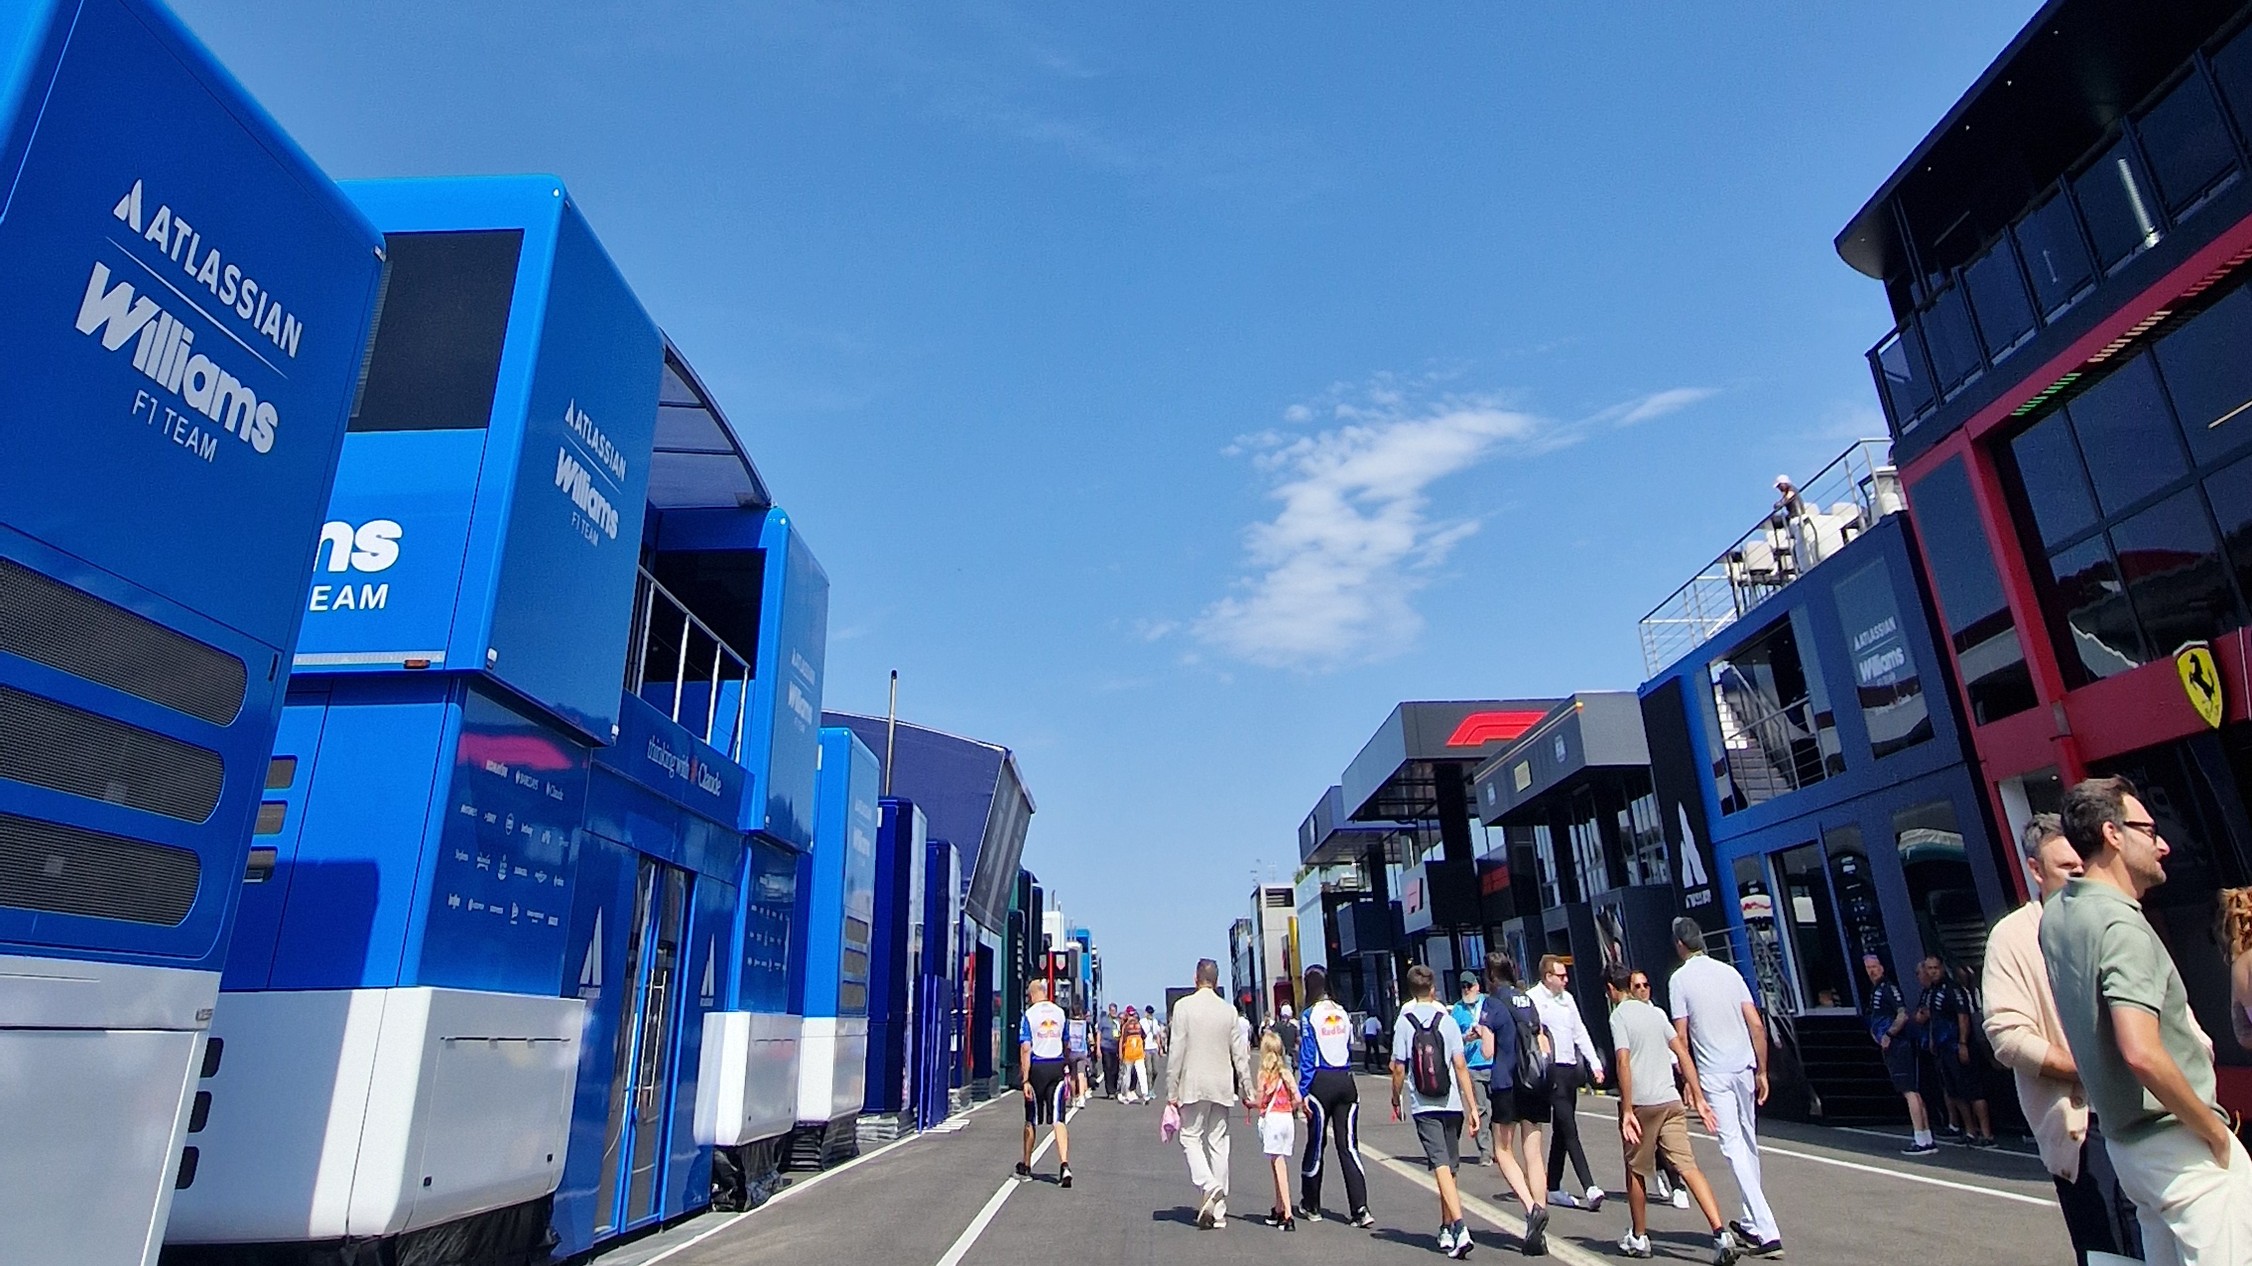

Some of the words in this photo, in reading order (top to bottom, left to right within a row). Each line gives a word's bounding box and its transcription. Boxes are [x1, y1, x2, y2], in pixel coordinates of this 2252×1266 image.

[145, 205, 302, 358] ATLASSIAN
[75, 261, 279, 453] Williams
[132, 390, 158, 424] F1
[164, 407, 218, 463] TEAM
[574, 409, 627, 482] ATLASSIAN
[555, 447, 619, 540] Williams
[580, 519, 599, 547] TEAM
[309, 584, 388, 611] EAM
[1859, 647, 1904, 682] Williams
[647, 735, 675, 778] thinking
[698, 762, 722, 797] Claude
